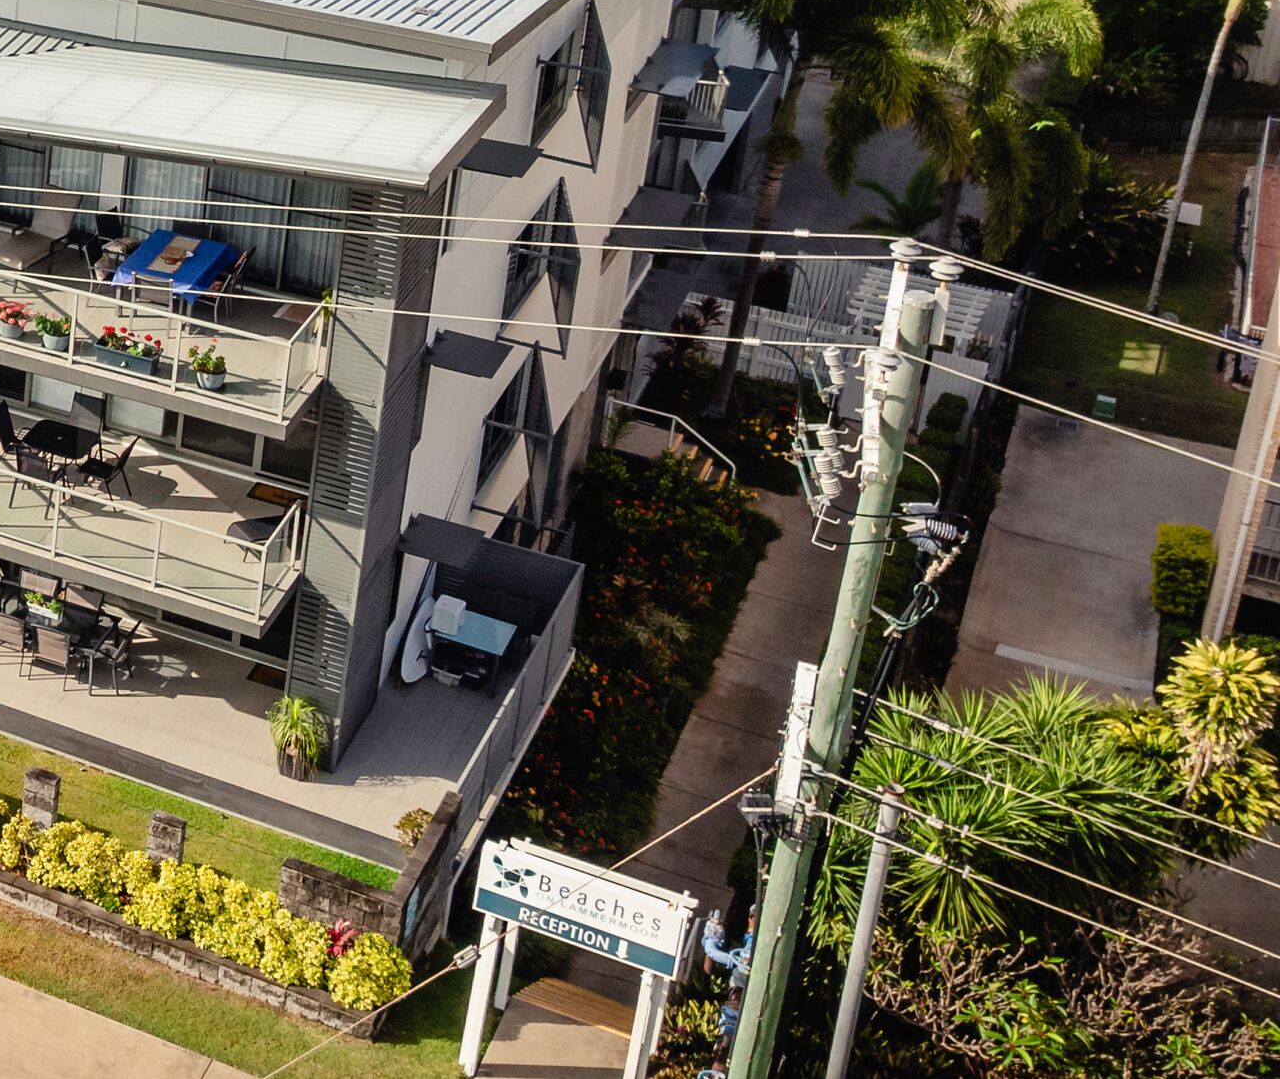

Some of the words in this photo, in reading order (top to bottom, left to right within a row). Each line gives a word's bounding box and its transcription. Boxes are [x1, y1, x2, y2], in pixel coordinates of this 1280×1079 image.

[536, 892, 555, 904] ON
[560, 899, 659, 940] LAMMERMOOR
[539, 874, 662, 932] Beaches
[518, 907, 610, 951] RECEPTION
